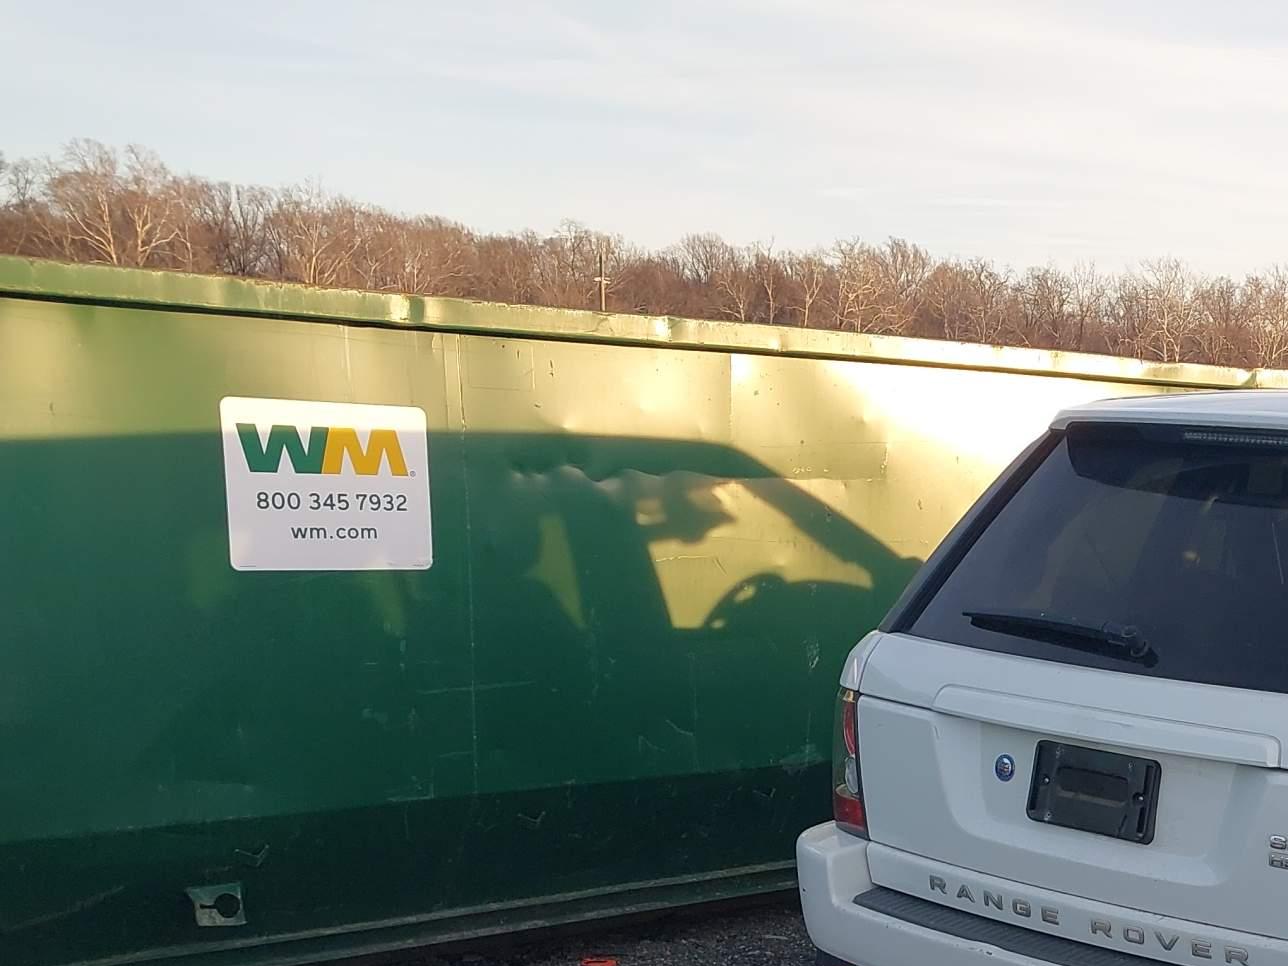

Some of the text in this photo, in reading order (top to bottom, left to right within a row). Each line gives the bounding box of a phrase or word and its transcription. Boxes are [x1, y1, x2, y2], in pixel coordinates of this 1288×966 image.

[236, 423, 409, 477] WM
[256, 492, 408, 512] 800 345 7932
[291, 526, 378, 540] wm.com
[929, 874, 1060, 926] RANGE
